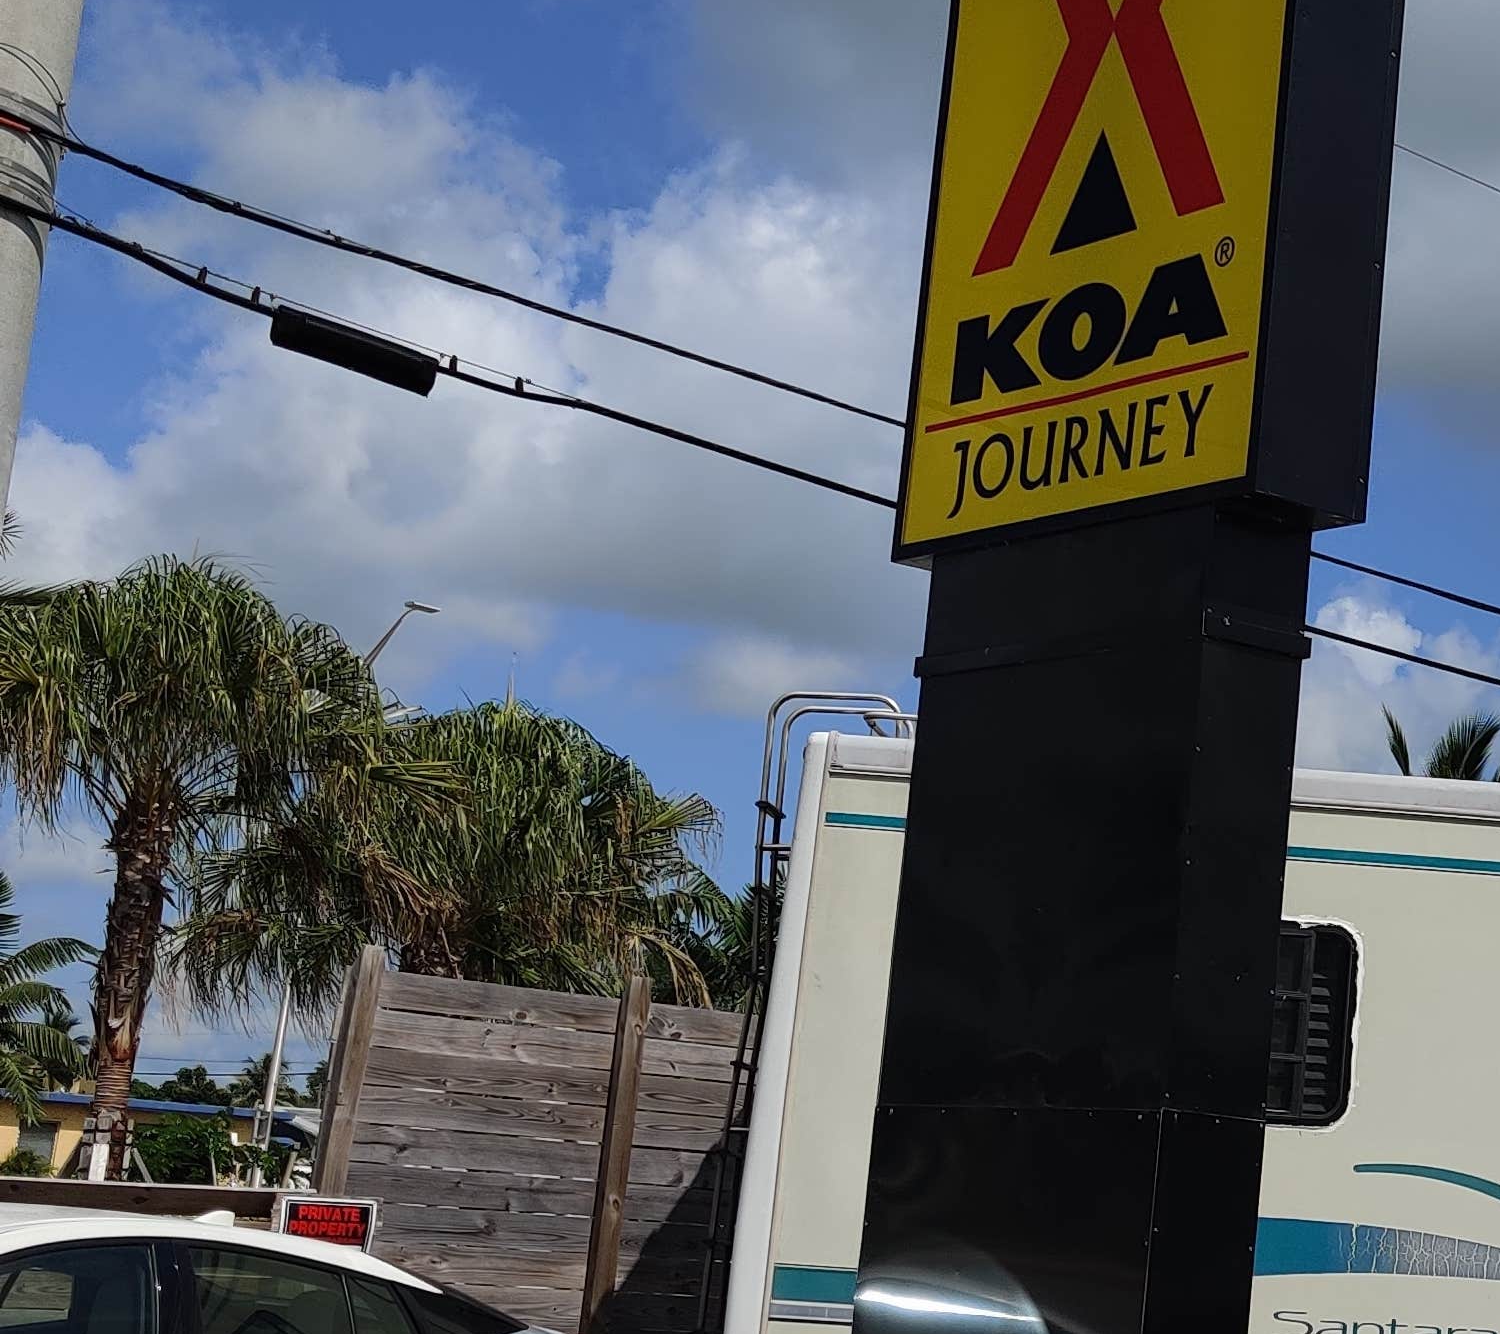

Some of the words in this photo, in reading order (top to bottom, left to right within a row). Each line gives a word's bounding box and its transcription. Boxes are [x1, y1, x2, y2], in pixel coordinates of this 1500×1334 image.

[949, 252, 1229, 407] KOA
[946, 383, 1215, 520] JOURNEY
[289, 1220, 366, 1237] PROPERTY
[298, 1205, 361, 1222] PRIVATE
